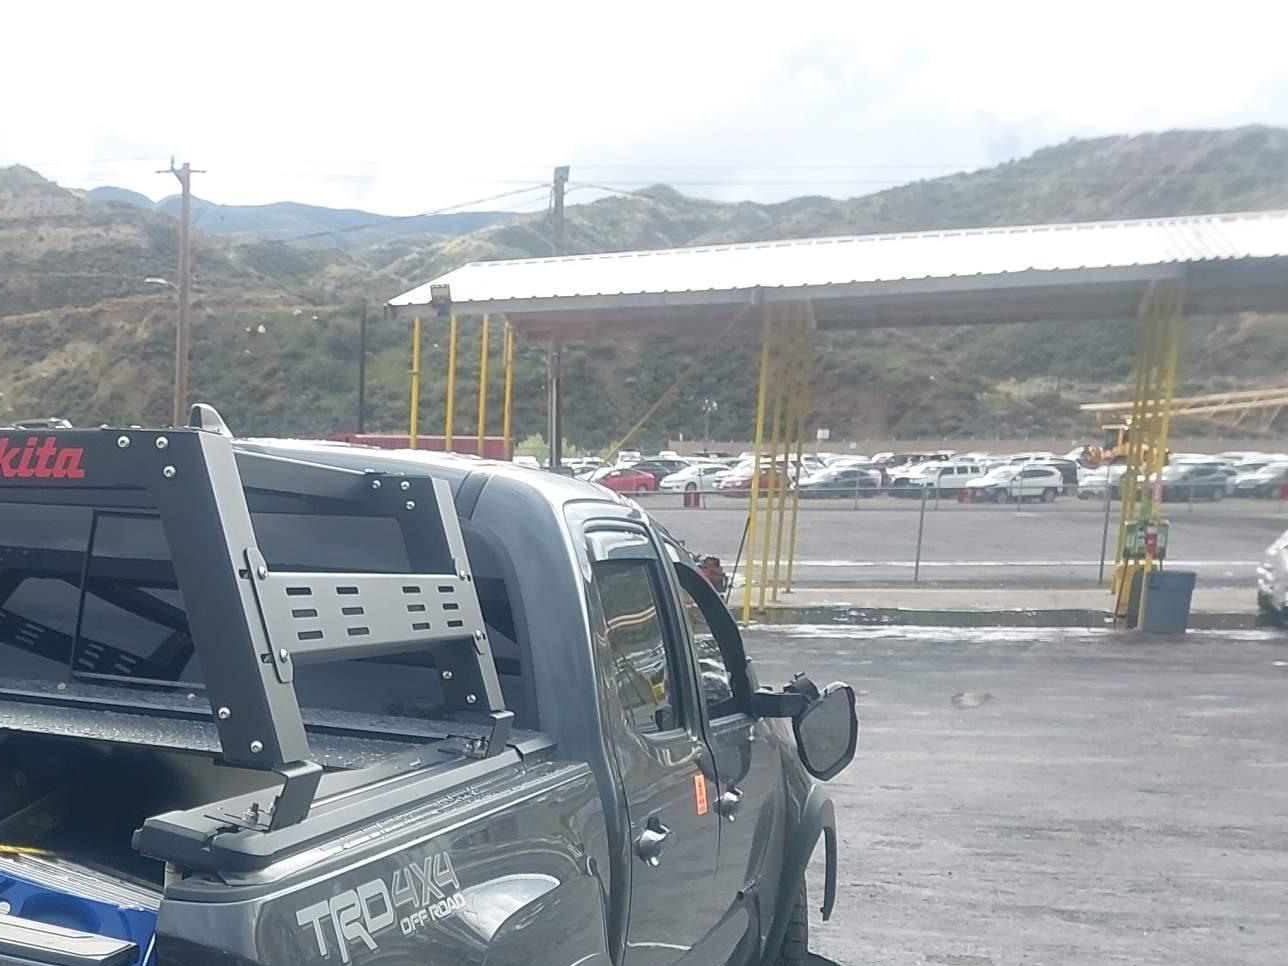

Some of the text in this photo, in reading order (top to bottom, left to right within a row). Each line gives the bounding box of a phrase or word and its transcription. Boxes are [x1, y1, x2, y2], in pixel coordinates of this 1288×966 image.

[296, 851, 460, 966] TRD 4X4
[400, 892, 467, 936] OFF ROAD
